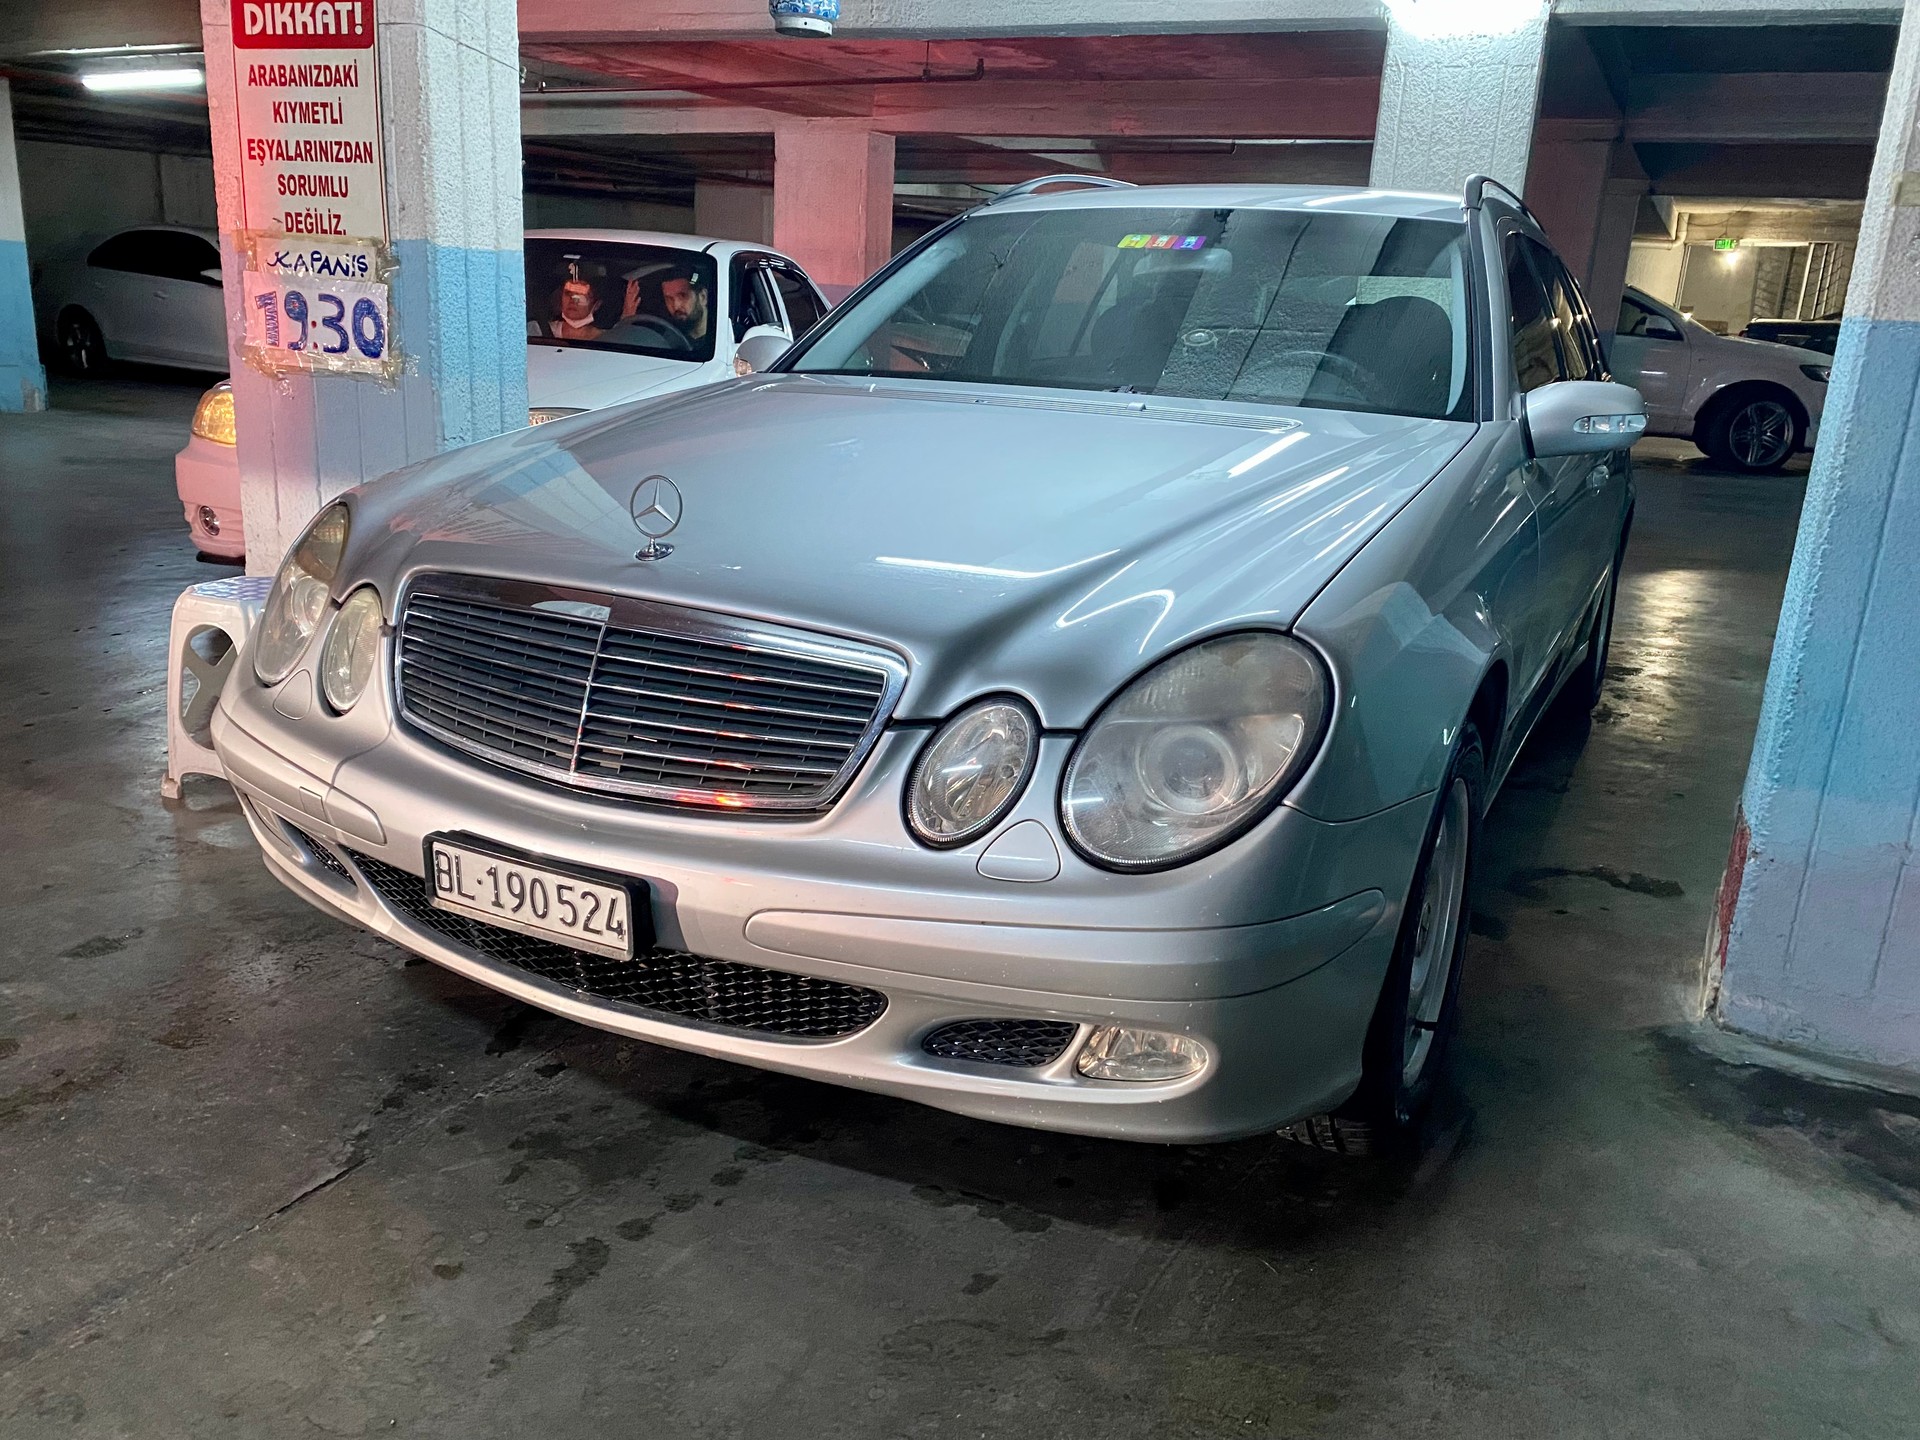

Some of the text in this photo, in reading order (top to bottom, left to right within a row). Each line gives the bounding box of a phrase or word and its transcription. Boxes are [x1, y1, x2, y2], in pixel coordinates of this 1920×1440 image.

[248, 59, 359, 88] ARABANIZDAKİ
[272, 96, 343, 125] KIYMETLİ
[247, 138, 374, 166] EŞYALARINIZDAN
[277, 174, 349, 198] SORUMLU
[284, 207, 347, 236] DEĞİLİZ.
